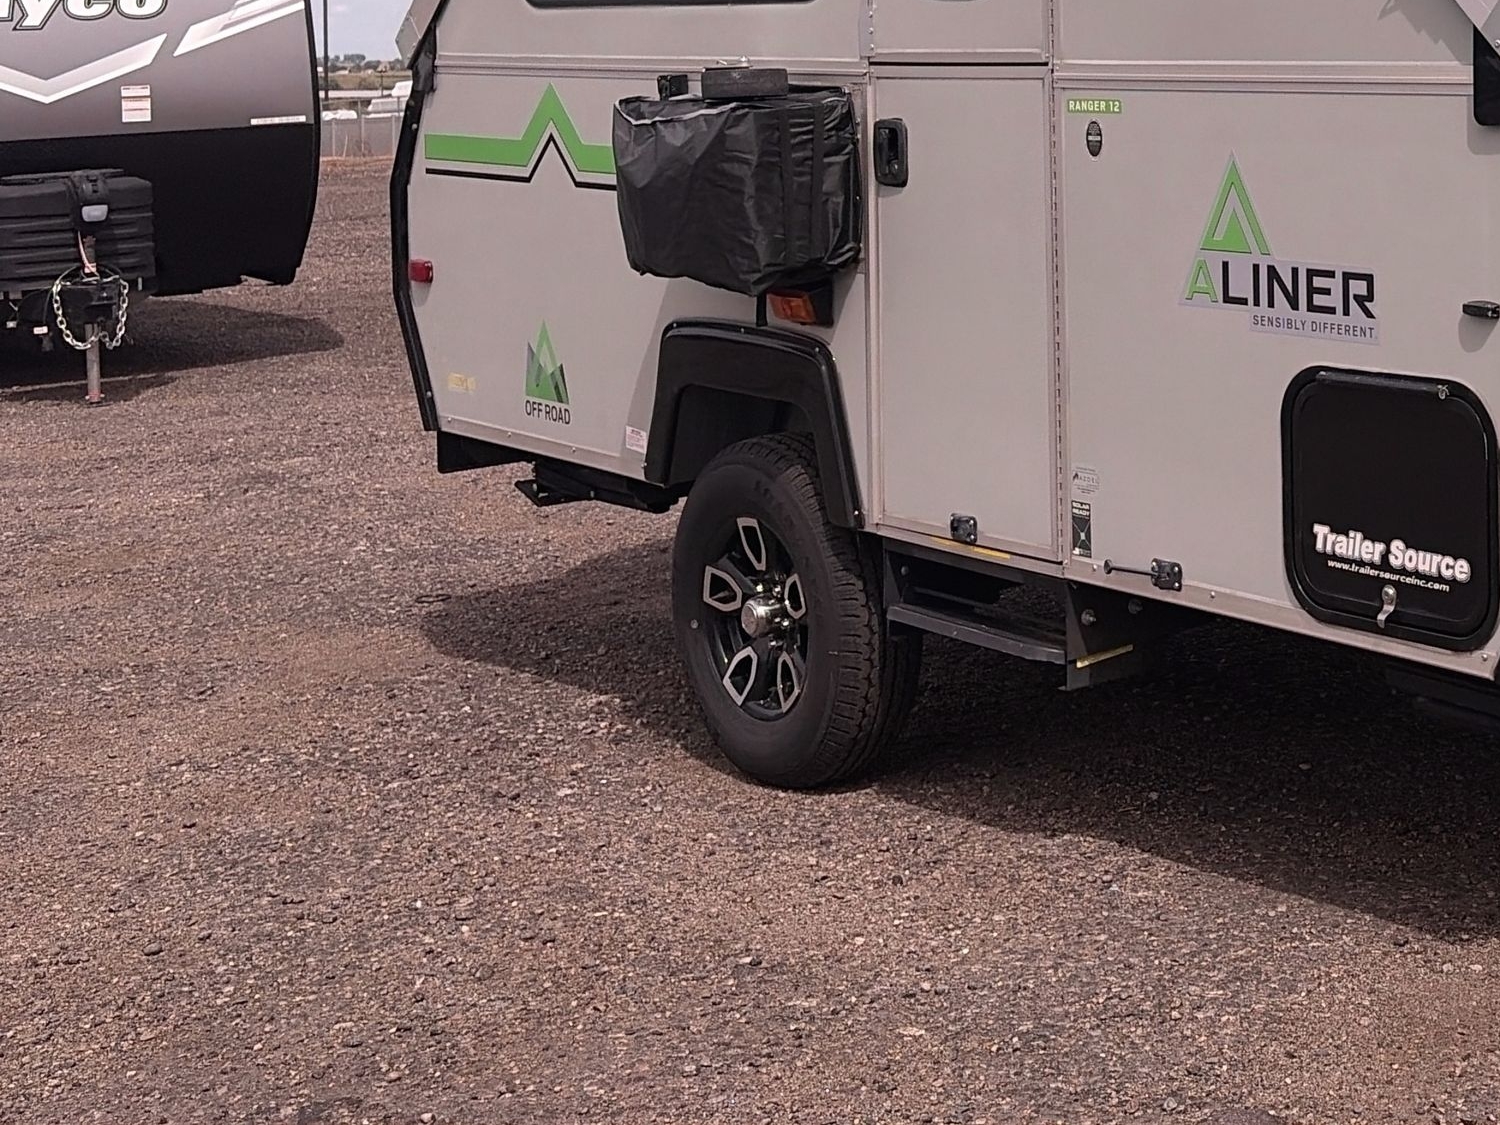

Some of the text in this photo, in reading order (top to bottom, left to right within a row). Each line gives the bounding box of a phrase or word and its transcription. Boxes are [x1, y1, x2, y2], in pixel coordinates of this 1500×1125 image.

[1068, 100, 1120, 112] RANGER 12
[1185, 257, 1377, 320] ALINER
[1252, 314, 1375, 339] SENSIBLY DIFFERENT
[525, 399, 571, 425] OFF ROAD
[1312, 522, 1471, 584] Trailer Source
[1327, 558, 1450, 593] www.trailersourceinc.com
